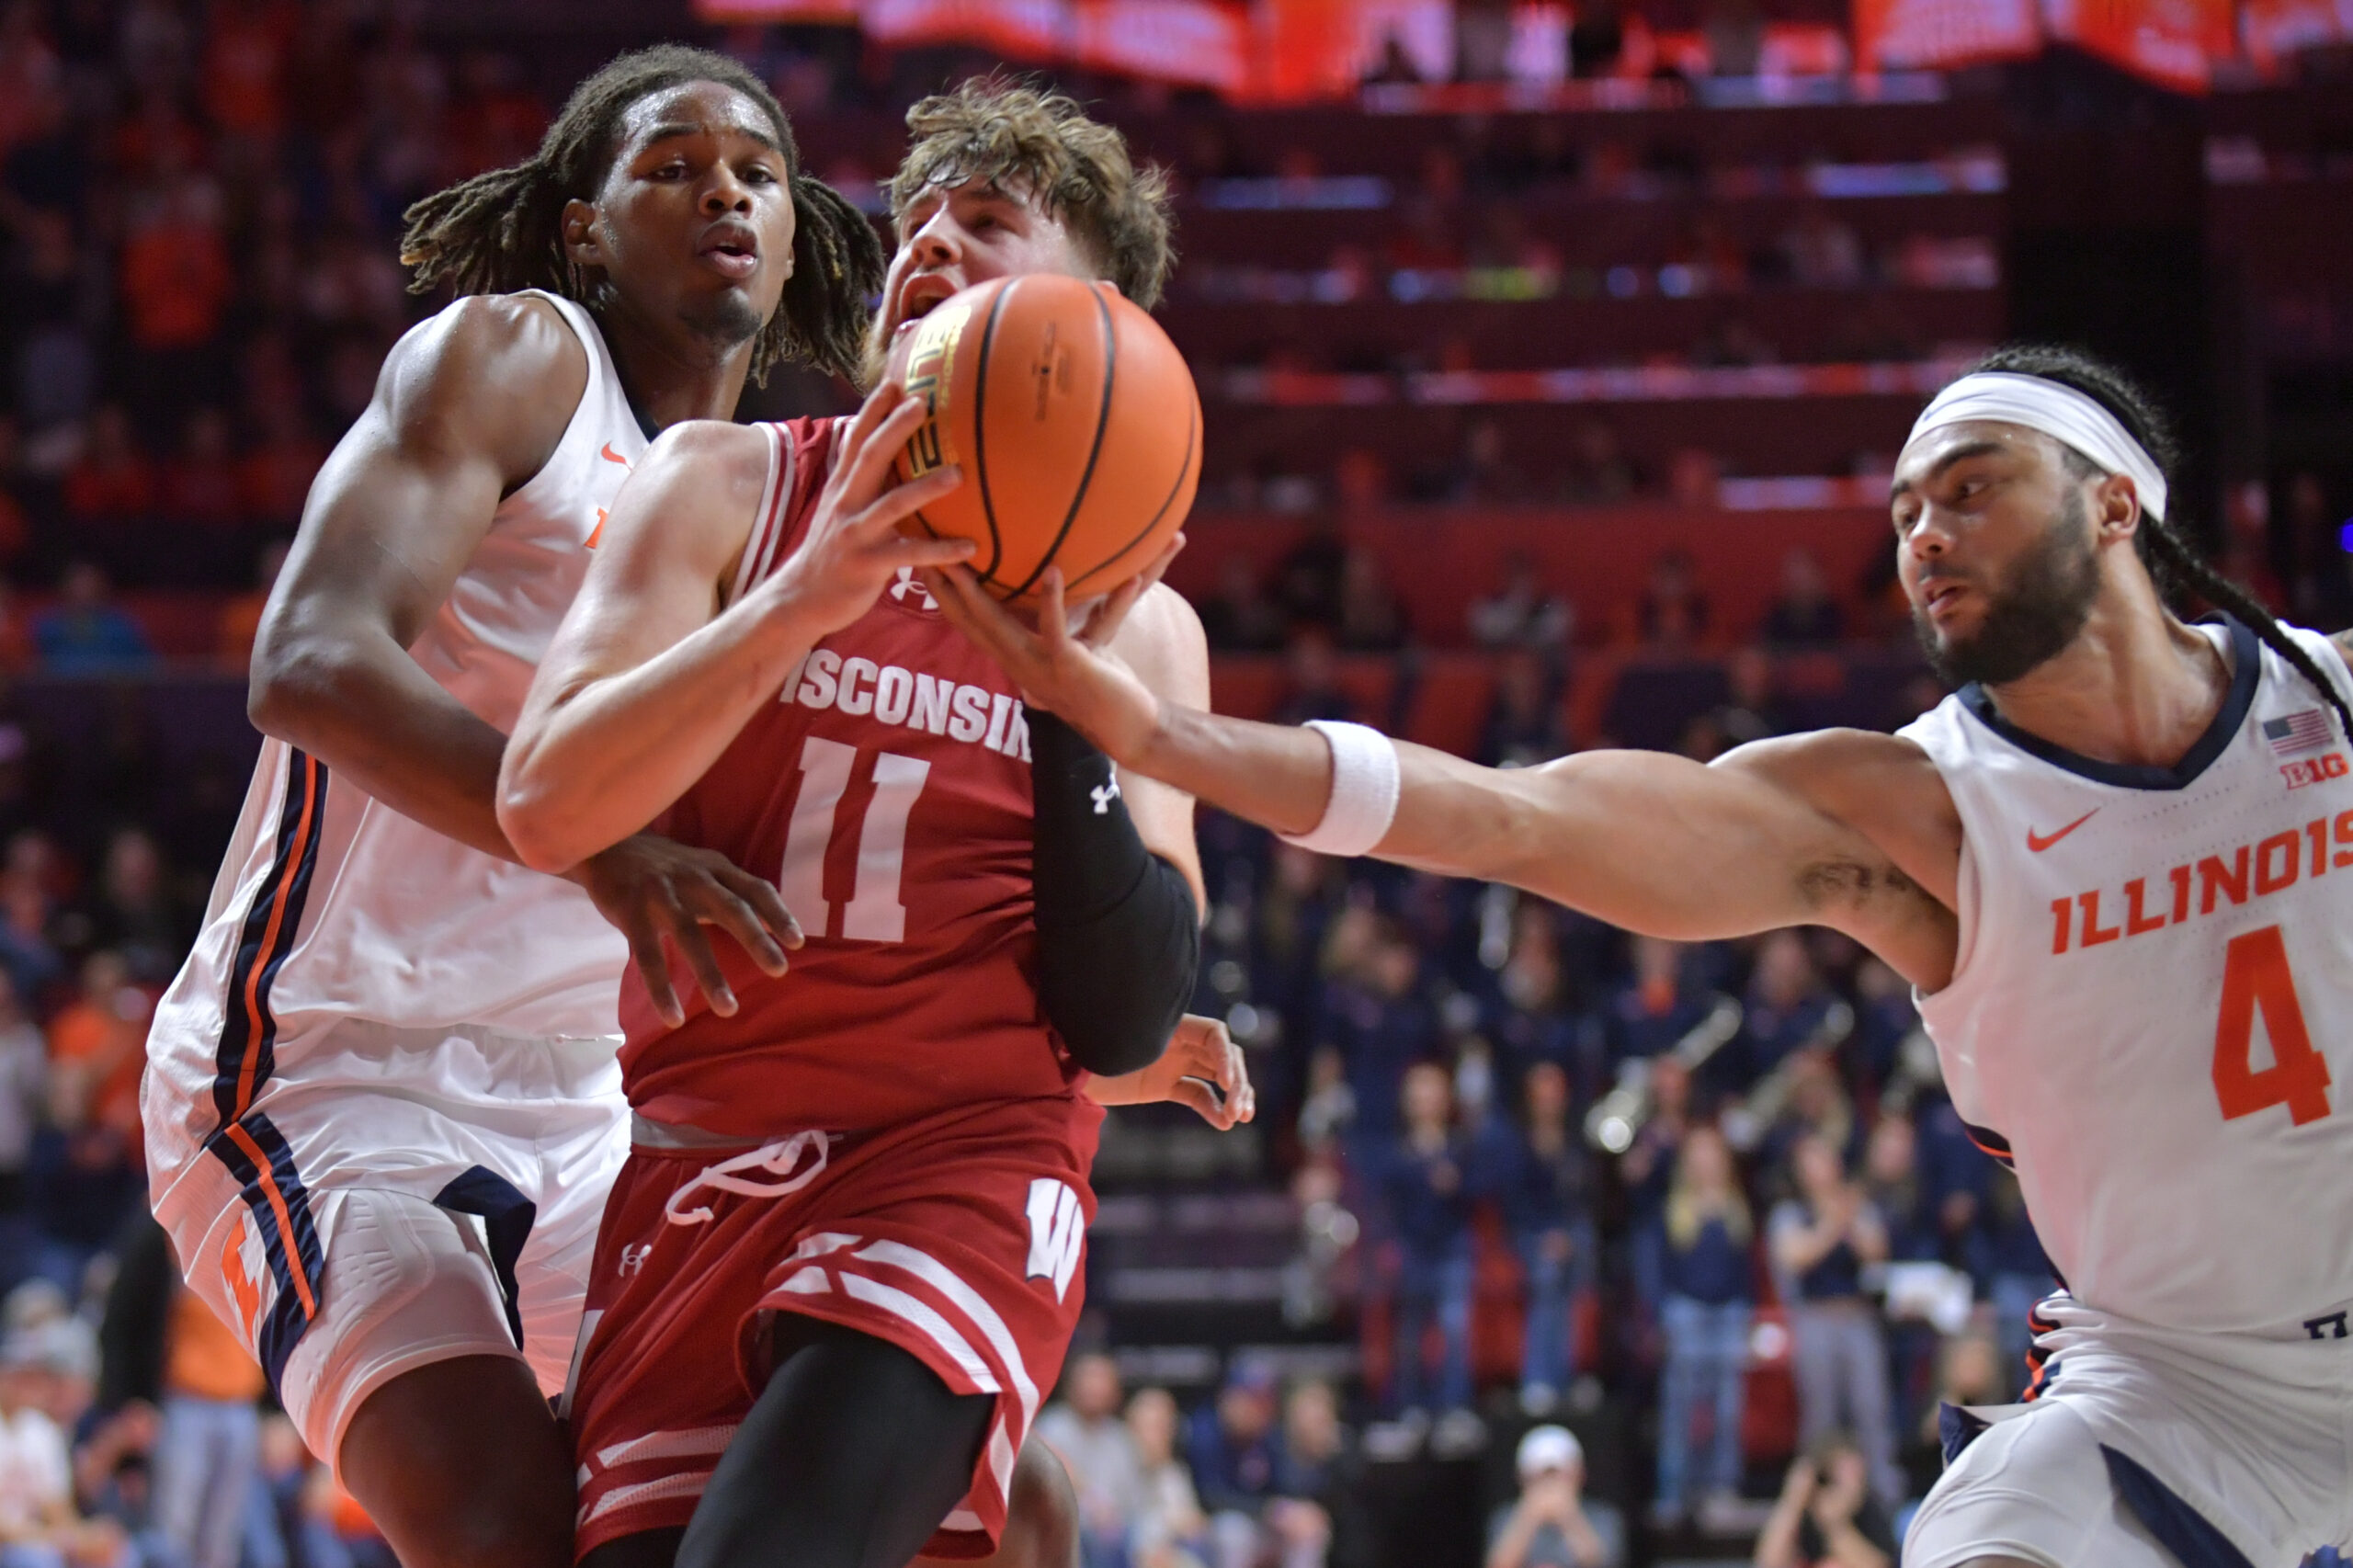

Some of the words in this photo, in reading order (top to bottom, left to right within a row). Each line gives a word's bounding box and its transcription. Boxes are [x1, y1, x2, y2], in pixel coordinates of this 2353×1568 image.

[779, 736, 931, 943] 11
[2212, 924, 2332, 1127] 4
[1025, 1177, 1086, 1306] W
